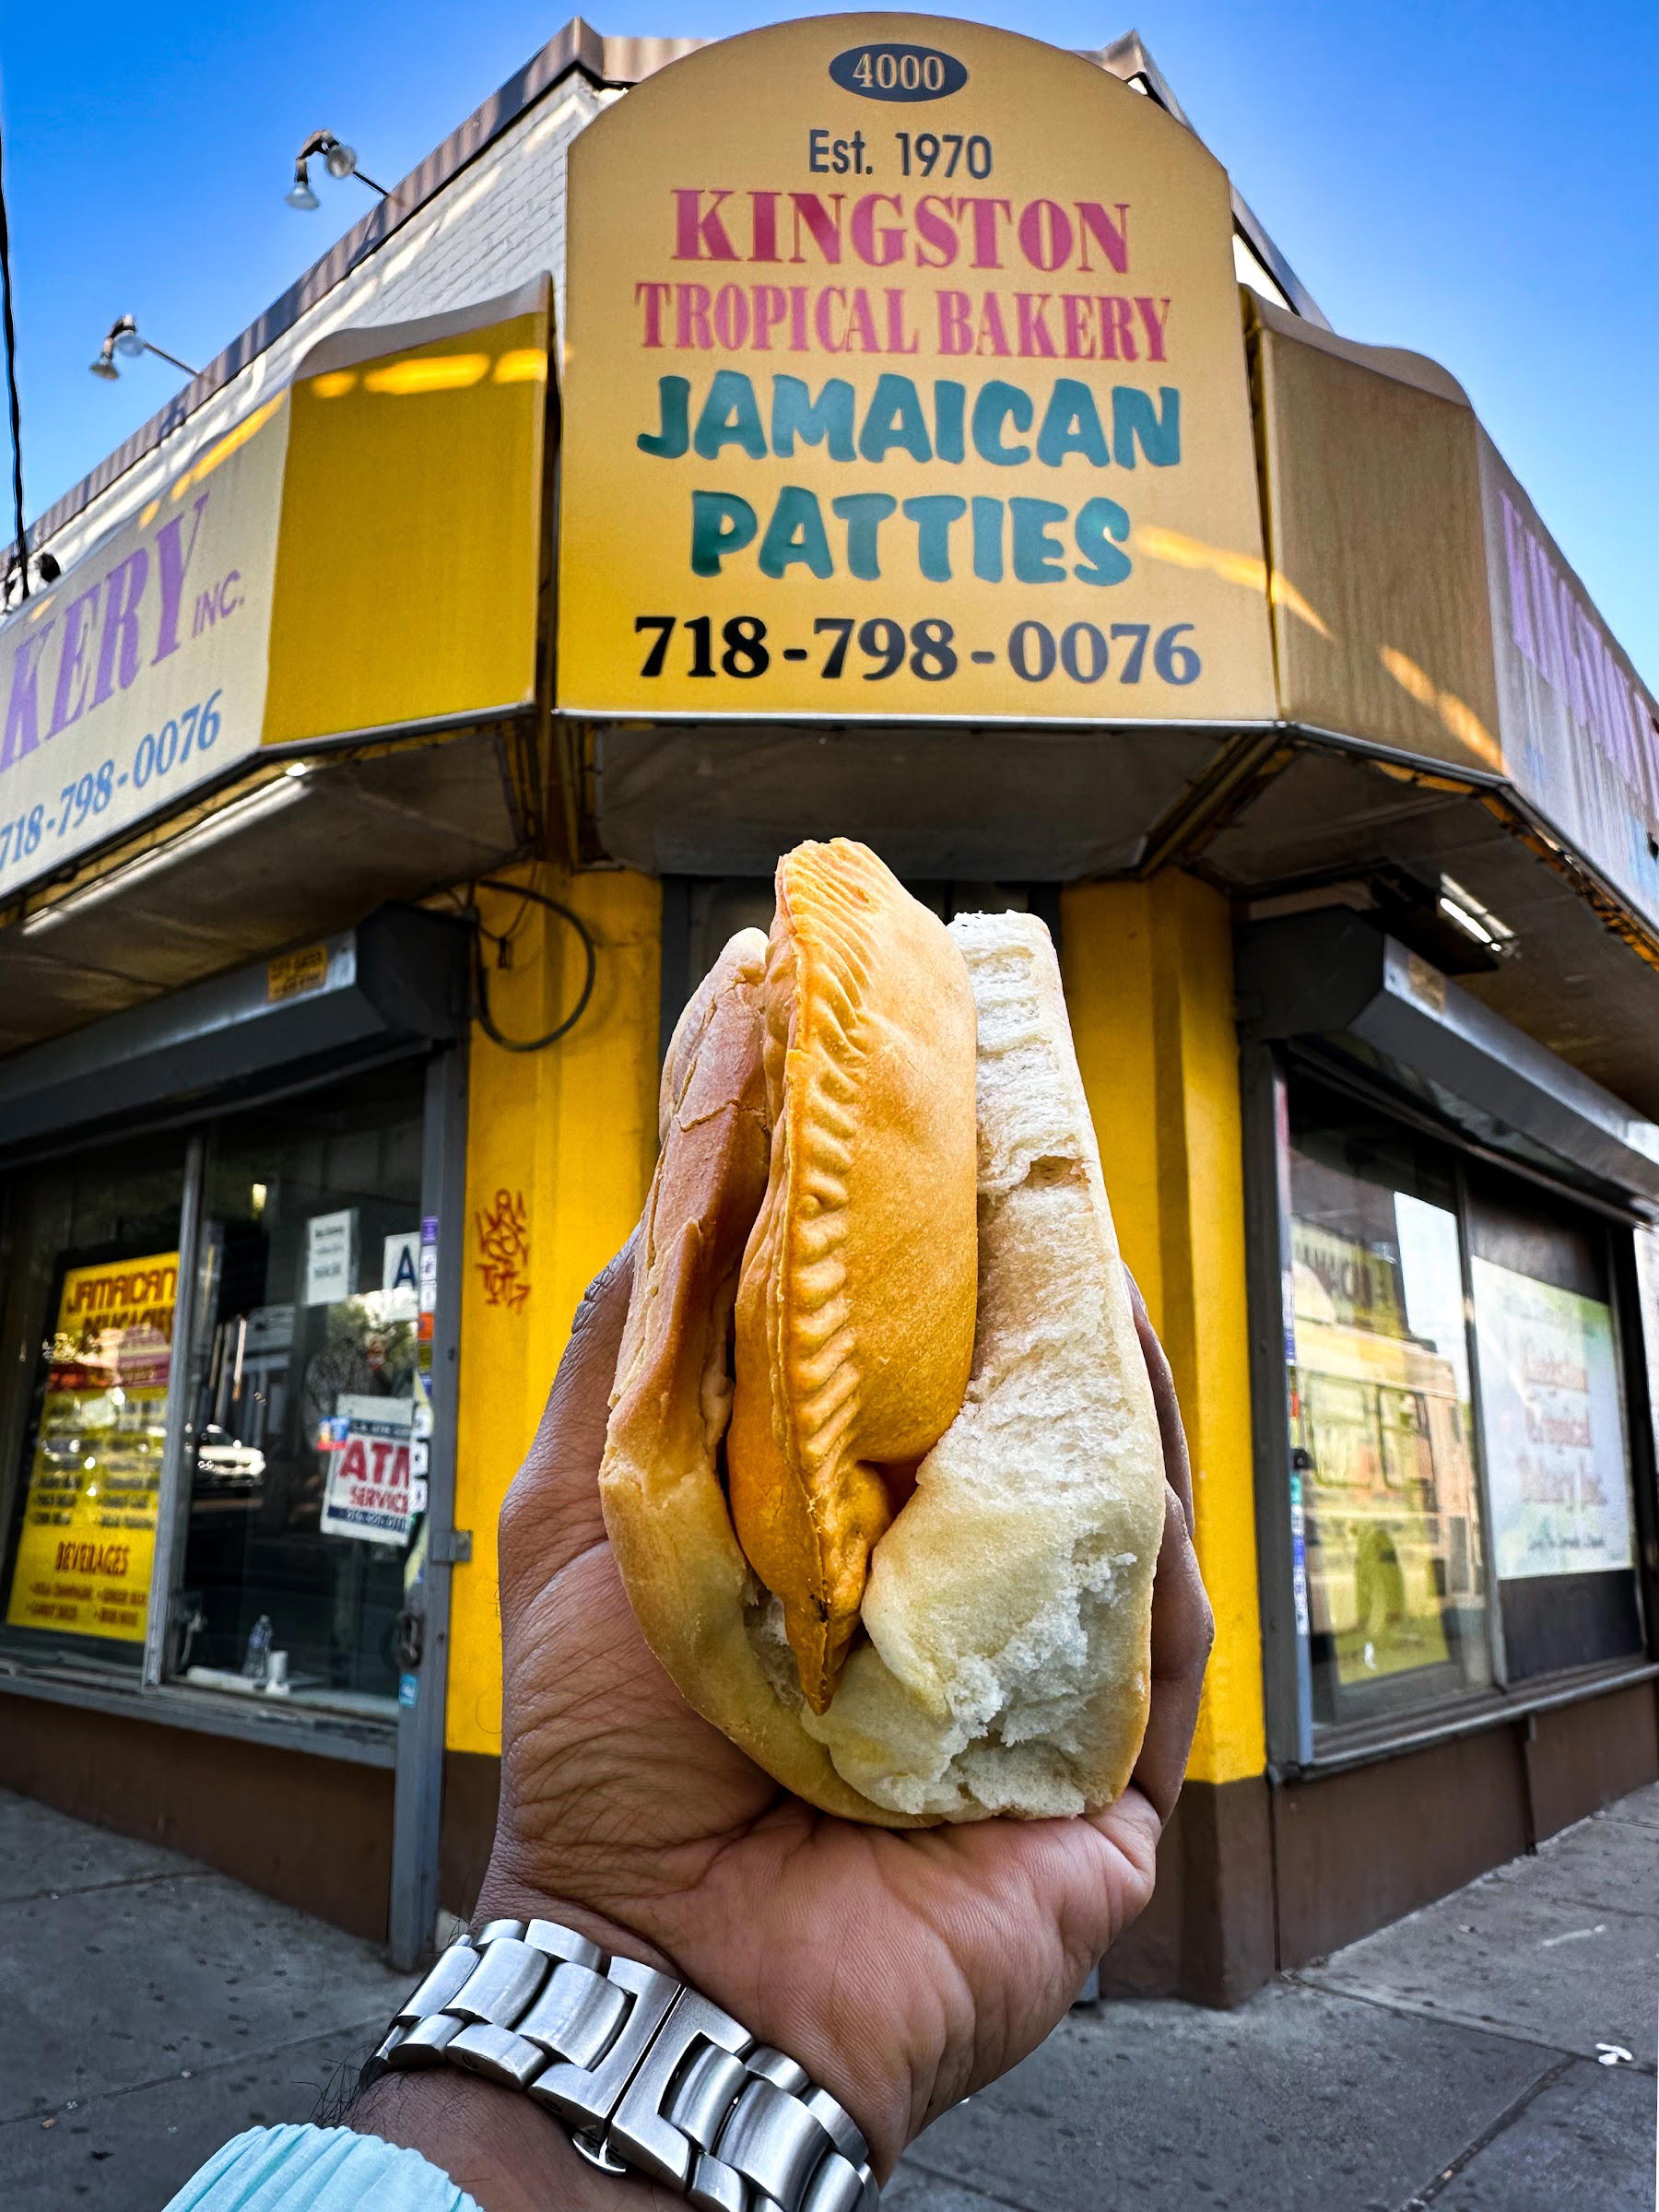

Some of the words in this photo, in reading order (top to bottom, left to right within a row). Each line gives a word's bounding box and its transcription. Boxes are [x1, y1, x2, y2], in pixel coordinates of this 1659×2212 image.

[853, 53, 946, 91] 4000
[809, 129, 873, 174] Est.
[895, 132, 993, 180] 1970
[671, 189, 1130, 274] KINGSTON
[635, 281, 920, 354] TROPICAL
[935, 289, 1172, 362] BAKERY
[636, 370, 1180, 470] JAMAICAN
[690, 486, 1133, 586] PATTIES
[191, 569, 246, 640] INC.
[634, 615, 1203, 686] 718-798-0076
[393, 1245, 419, 1290] A
